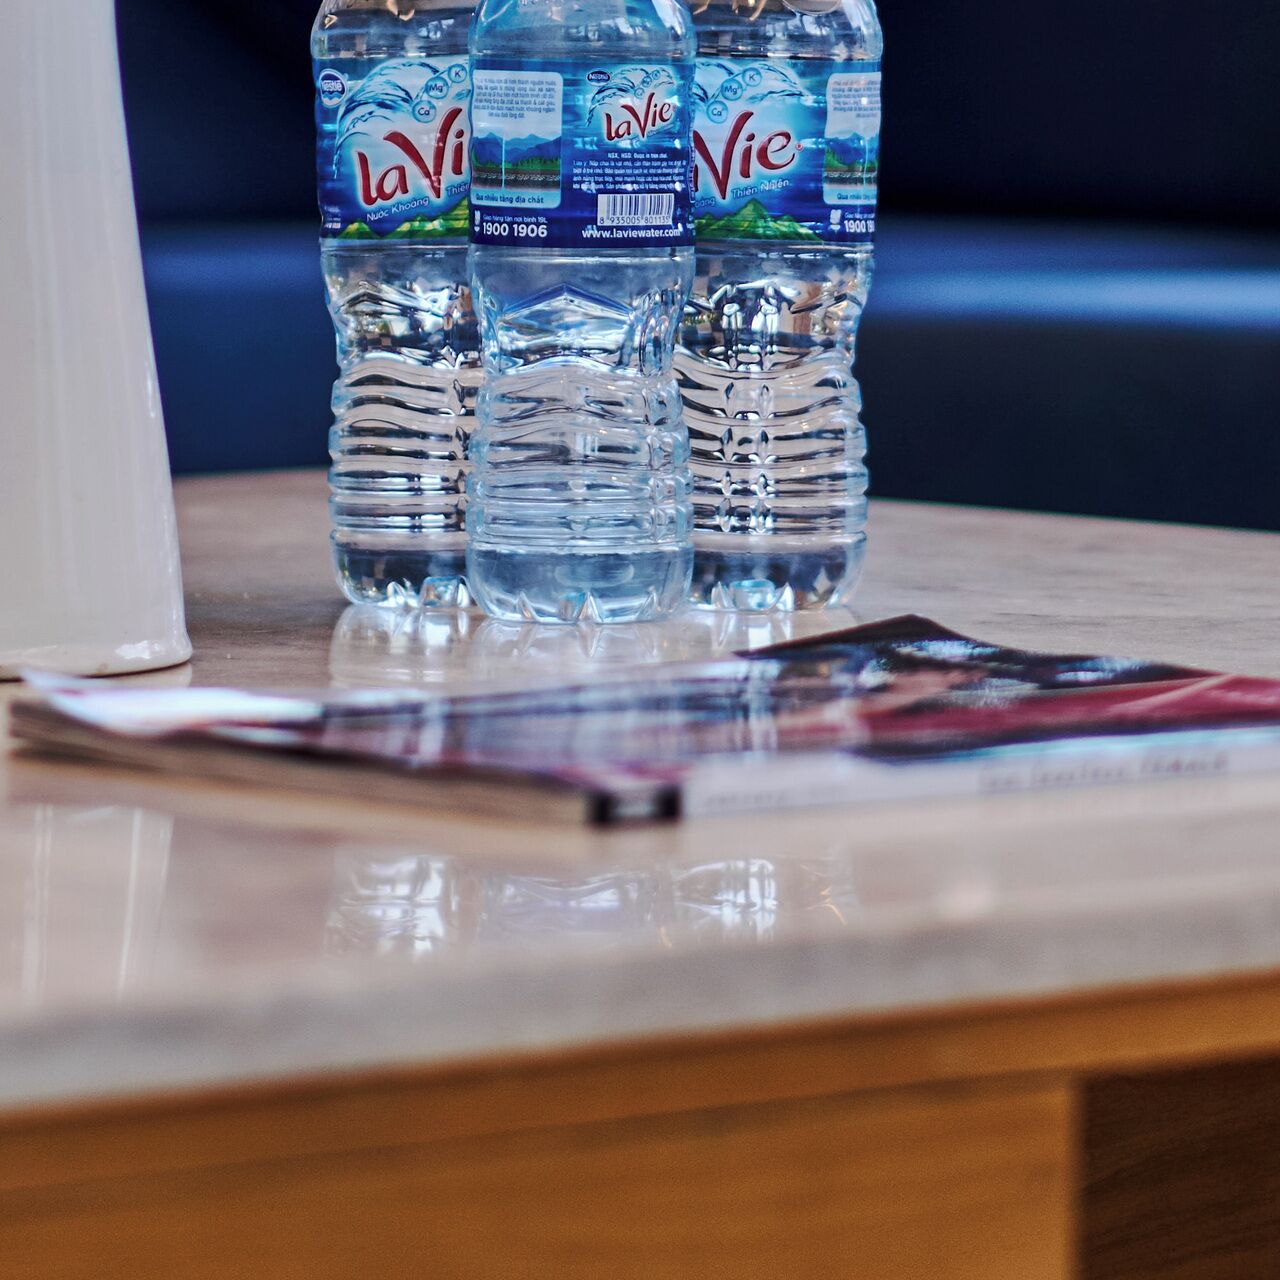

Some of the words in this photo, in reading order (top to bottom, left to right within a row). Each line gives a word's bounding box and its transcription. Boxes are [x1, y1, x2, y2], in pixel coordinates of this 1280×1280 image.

[357, 106, 464, 207] laVi
[693, 109, 796, 200] Vie
[599, 216, 605, 224] 8
[844, 220, 867, 233] 1900
[482, 222, 509, 236] 1900
[512, 224, 548, 237] 1906
[582, 228, 681, 239] www.laviewater.com
